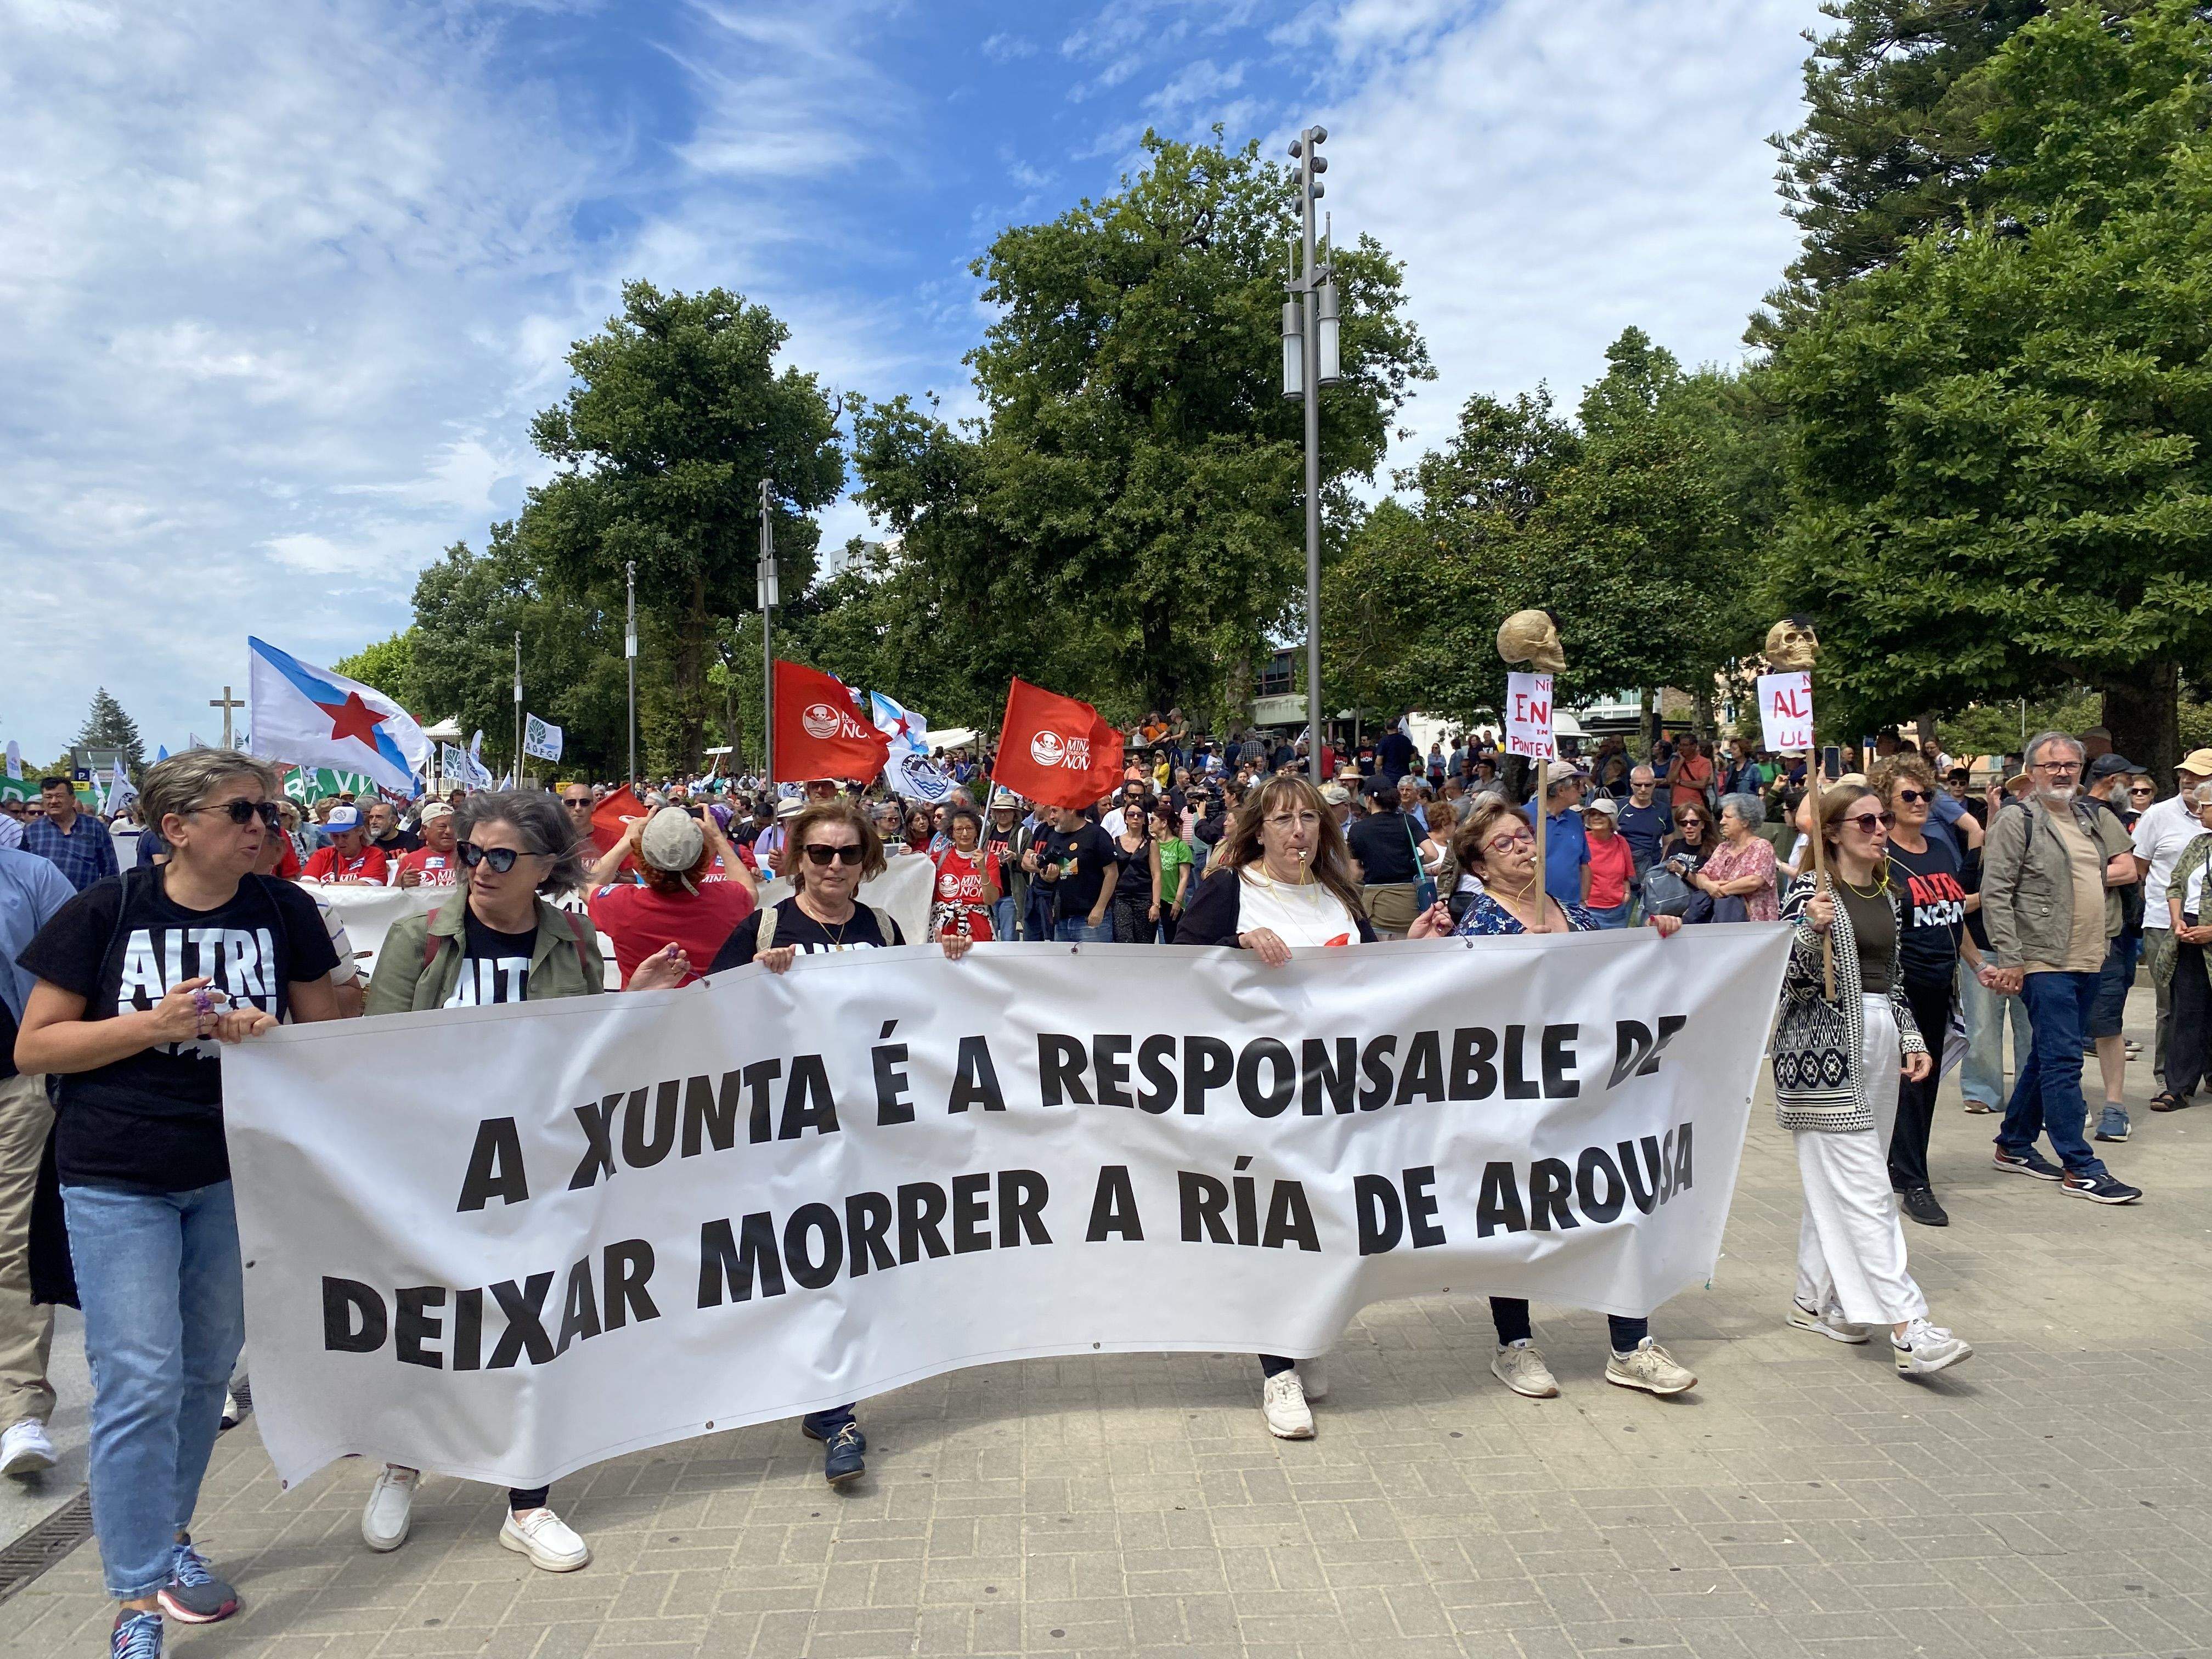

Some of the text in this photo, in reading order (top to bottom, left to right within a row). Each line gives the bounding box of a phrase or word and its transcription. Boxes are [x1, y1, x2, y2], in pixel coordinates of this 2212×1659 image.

[1515, 693, 1553, 725] EN
[1908, 872, 1966, 906] ALTRI
[456, 1014, 1688, 1212] A XUNTA É A RESPONSABLE DE
[321, 1121, 1693, 1371] DEIXAR MORRER A RÍA DE AROUSA
